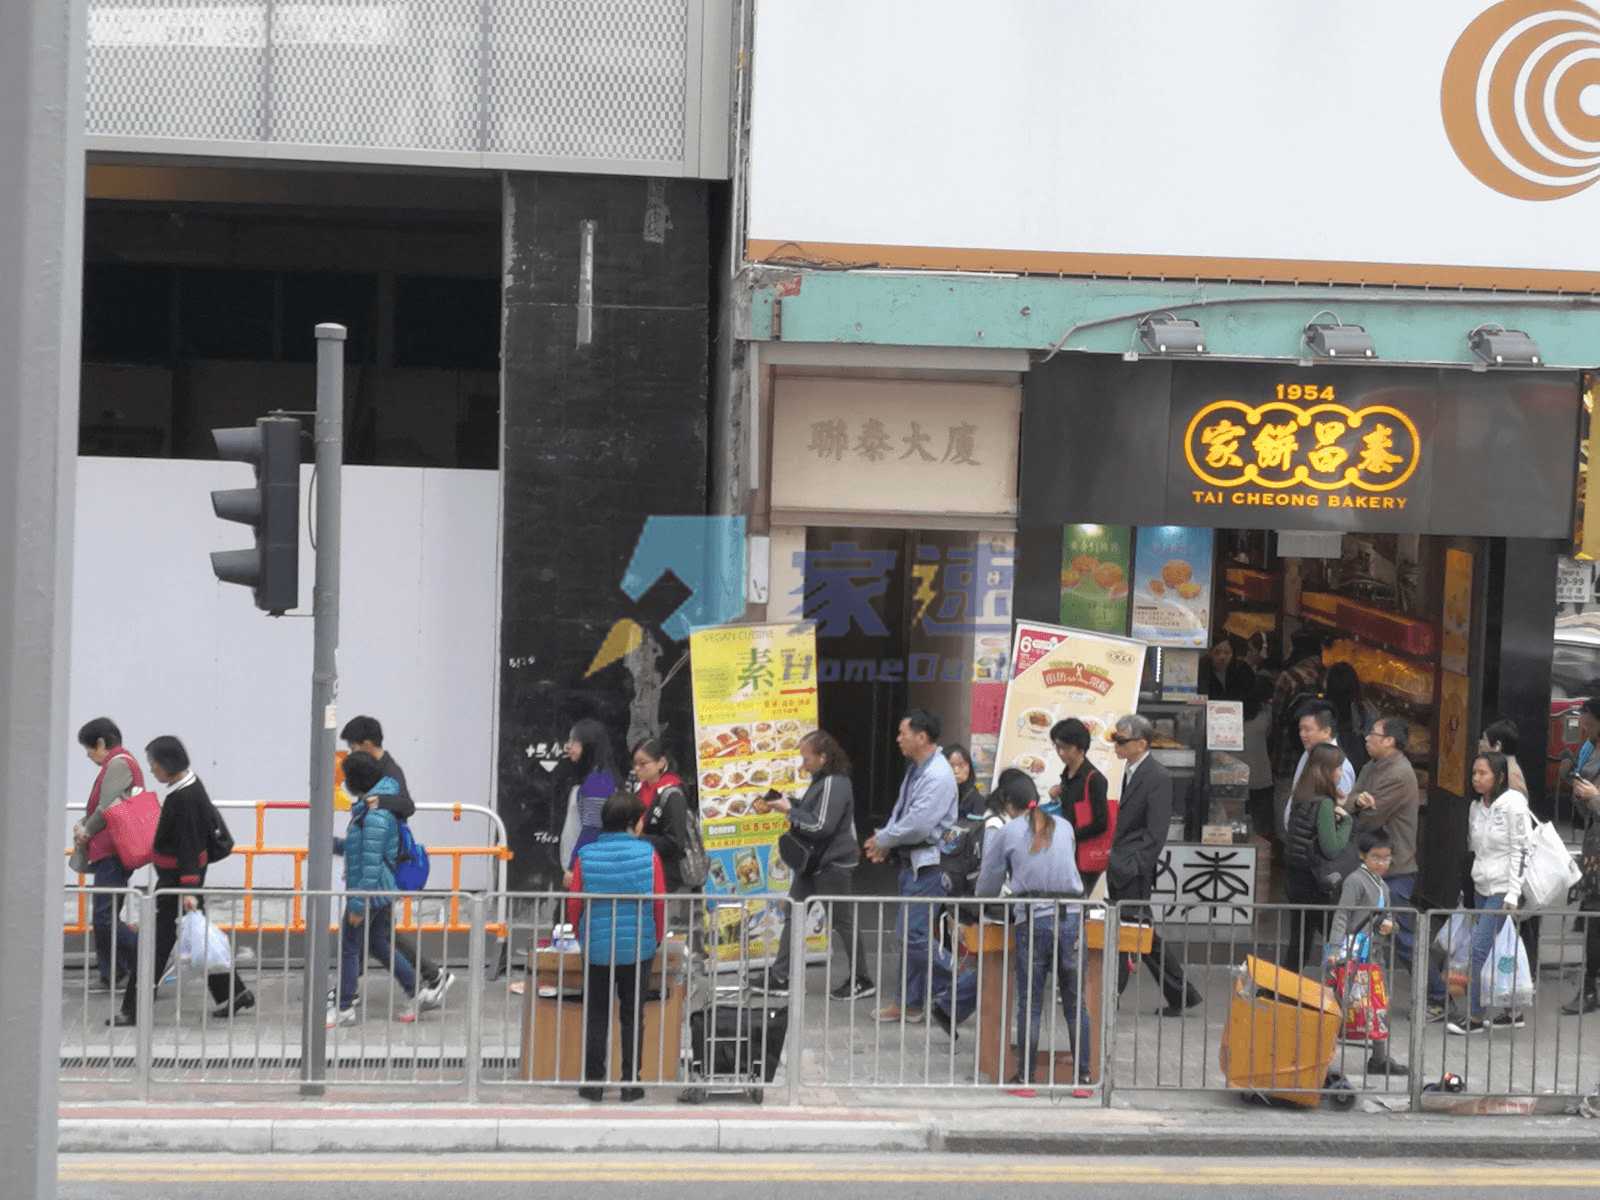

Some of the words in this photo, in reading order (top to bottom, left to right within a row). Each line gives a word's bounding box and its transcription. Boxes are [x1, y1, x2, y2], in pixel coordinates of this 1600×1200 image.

[1276, 384, 1335, 401] 1954
[807, 417, 981, 466] 聯泰大廈
[1192, 491, 1224, 504] TAI
[1231, 492, 1319, 507] CHEONG
[1328, 496, 1408, 509] BAKERY
[1020, 636, 1032, 653] 6
[737, 648, 775, 691] 素
